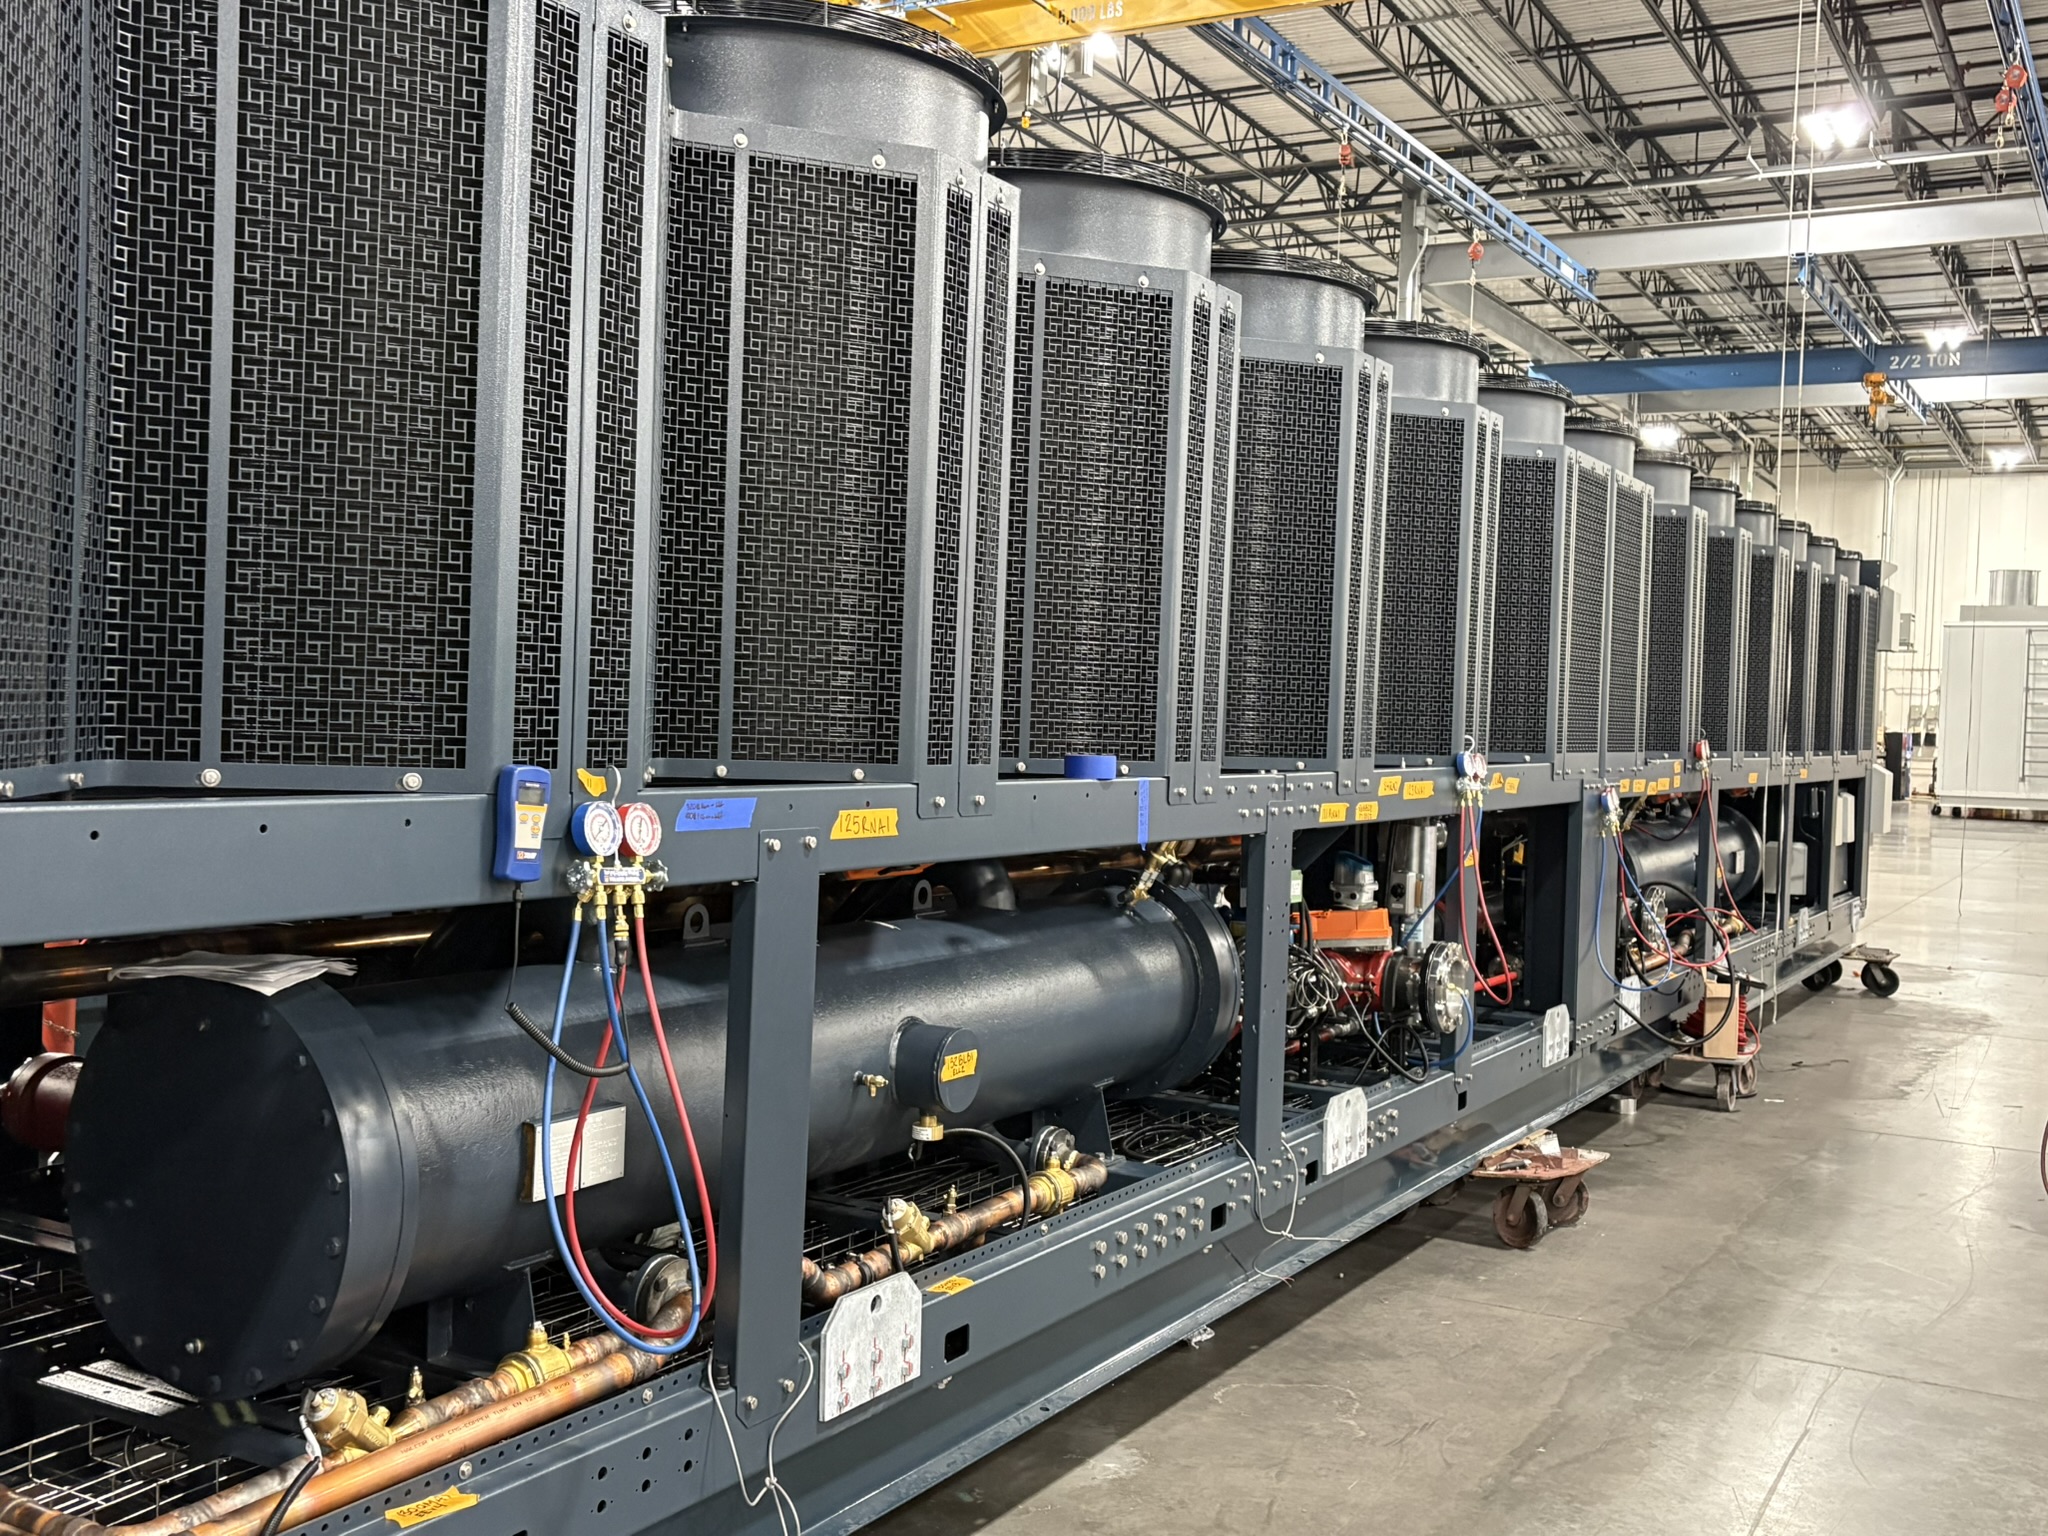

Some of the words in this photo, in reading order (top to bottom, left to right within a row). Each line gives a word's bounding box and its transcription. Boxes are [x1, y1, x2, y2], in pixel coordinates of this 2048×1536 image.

[1099, 1, 1124, 20] LBS
[1889, 354, 1922, 369] 2/2
[1927, 351, 1961, 367] TON
[840, 813, 890, 835] 125RNA1
